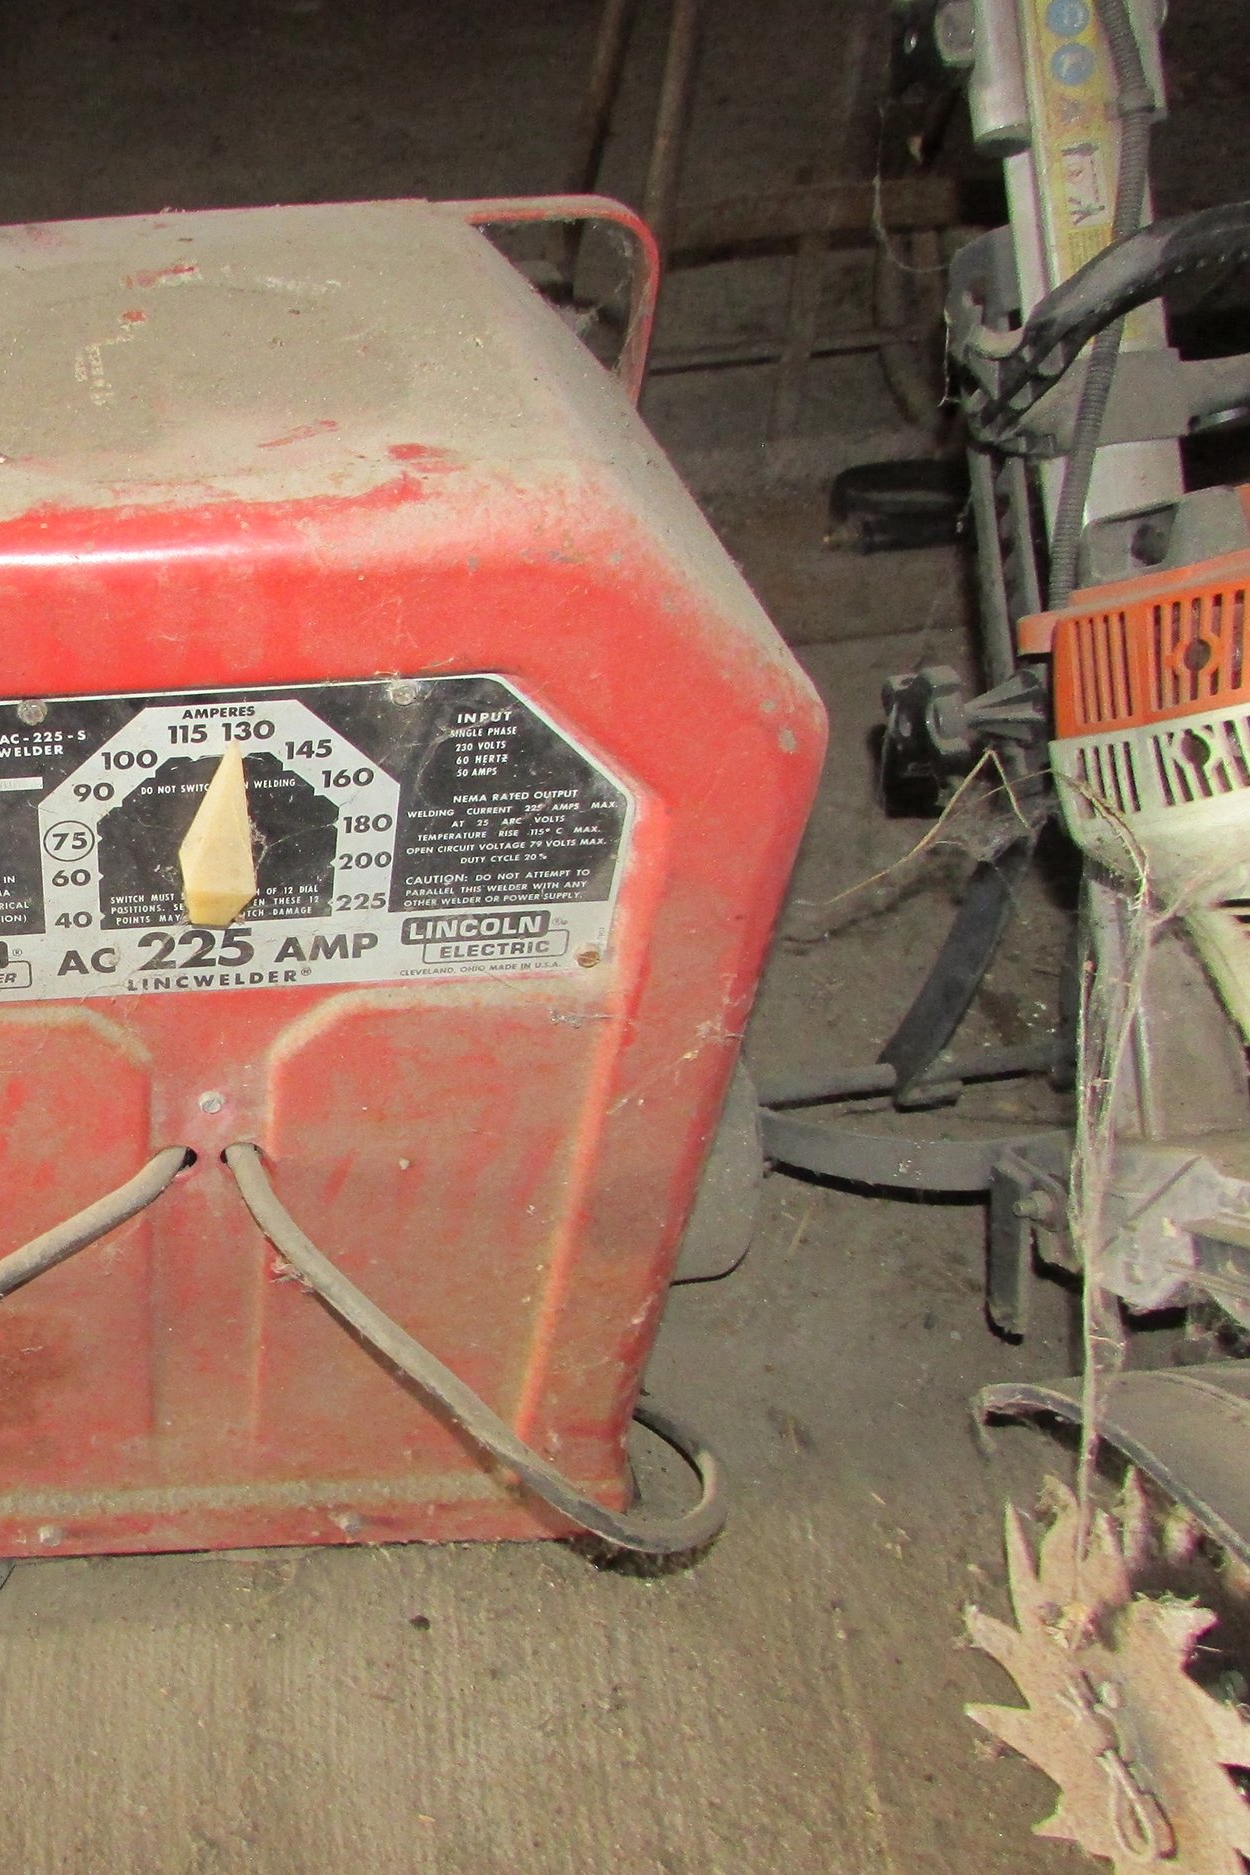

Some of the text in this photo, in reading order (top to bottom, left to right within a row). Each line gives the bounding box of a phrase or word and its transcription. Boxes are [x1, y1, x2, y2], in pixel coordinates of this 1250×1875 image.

[182, 705, 255, 720] AMPERES
[457, 711, 512, 723] INPUT
[167, 723, 208, 744] 115
[222, 719, 275, 741] 130
[450, 726, 517, 738] SINGLE PHASE
[285, 738, 333, 759] 145
[455, 741, 506, 752] 230 VOLTS
[101, 749, 158, 770] 100
[456, 754, 508, 765] 60 HERTZ
[322, 767, 374, 788] 160
[457, 767, 497, 777] 50 AMPS
[73, 782, 115, 802] 90
[141, 787, 153, 795] DO
[158, 785, 176, 794] NOT
[254, 779, 295, 788] WELDING
[453, 789, 578, 803] NEMA RATED OUTPUT
[407, 800, 619, 818] WELDING CURRENT 225 AMPS MAX.
[343, 813, 393, 834] 180
[451, 820, 464, 828] AT
[501, 817, 522, 825] ARC
[534, 815, 565, 824] VOLTS
[52, 831, 88, 851] 75
[417, 831, 487, 842] TEMPERATURE
[498, 829, 519, 838] RISE
[556, 827, 562, 835] C
[573, 825, 601, 834] MAX.
[406, 837, 607, 855] OPEN CIRCUIT VOLTAGE 79 VOLTS MAX.
[339, 851, 392, 870] 200
[460, 856, 485, 864] DUTY
[491, 854, 520, 862] CYCLE
[51, 869, 91, 887] 60
[405, 868, 590, 885] CAUTION: DO NOT ATTEMPT TO
[111, 895, 145, 904] SWITCH
[266, 887, 277, 895] OF
[405, 887, 454, 896] PARALLEL
[485, 883, 527, 892] WELDER
[533, 882, 559, 890] WITH
[563, 880, 587, 888] ANY
[111, 904, 165, 914] POSITIONS.
[274, 896, 301, 905] THESE
[309, 895, 319, 903] 12
[335, 893, 386, 912] 225
[404, 898, 437, 907] OTHER
[441, 896, 480, 905] WELDER
[503, 893, 540, 901] POWER
[543, 891, 582, 900] SUPPLY.
[55, 912, 93, 929] 40
[116, 915, 150, 925] POINTS
[159, 914, 179, 922] MAY
[272, 907, 312, 915] DAMAGE
[409, 916, 541, 940] LINCOLN
[57, 928, 378, 976] AC 225 AMP
[440, 940, 550, 959] ELECTRIC
[460, 965, 485, 973] OHIO
